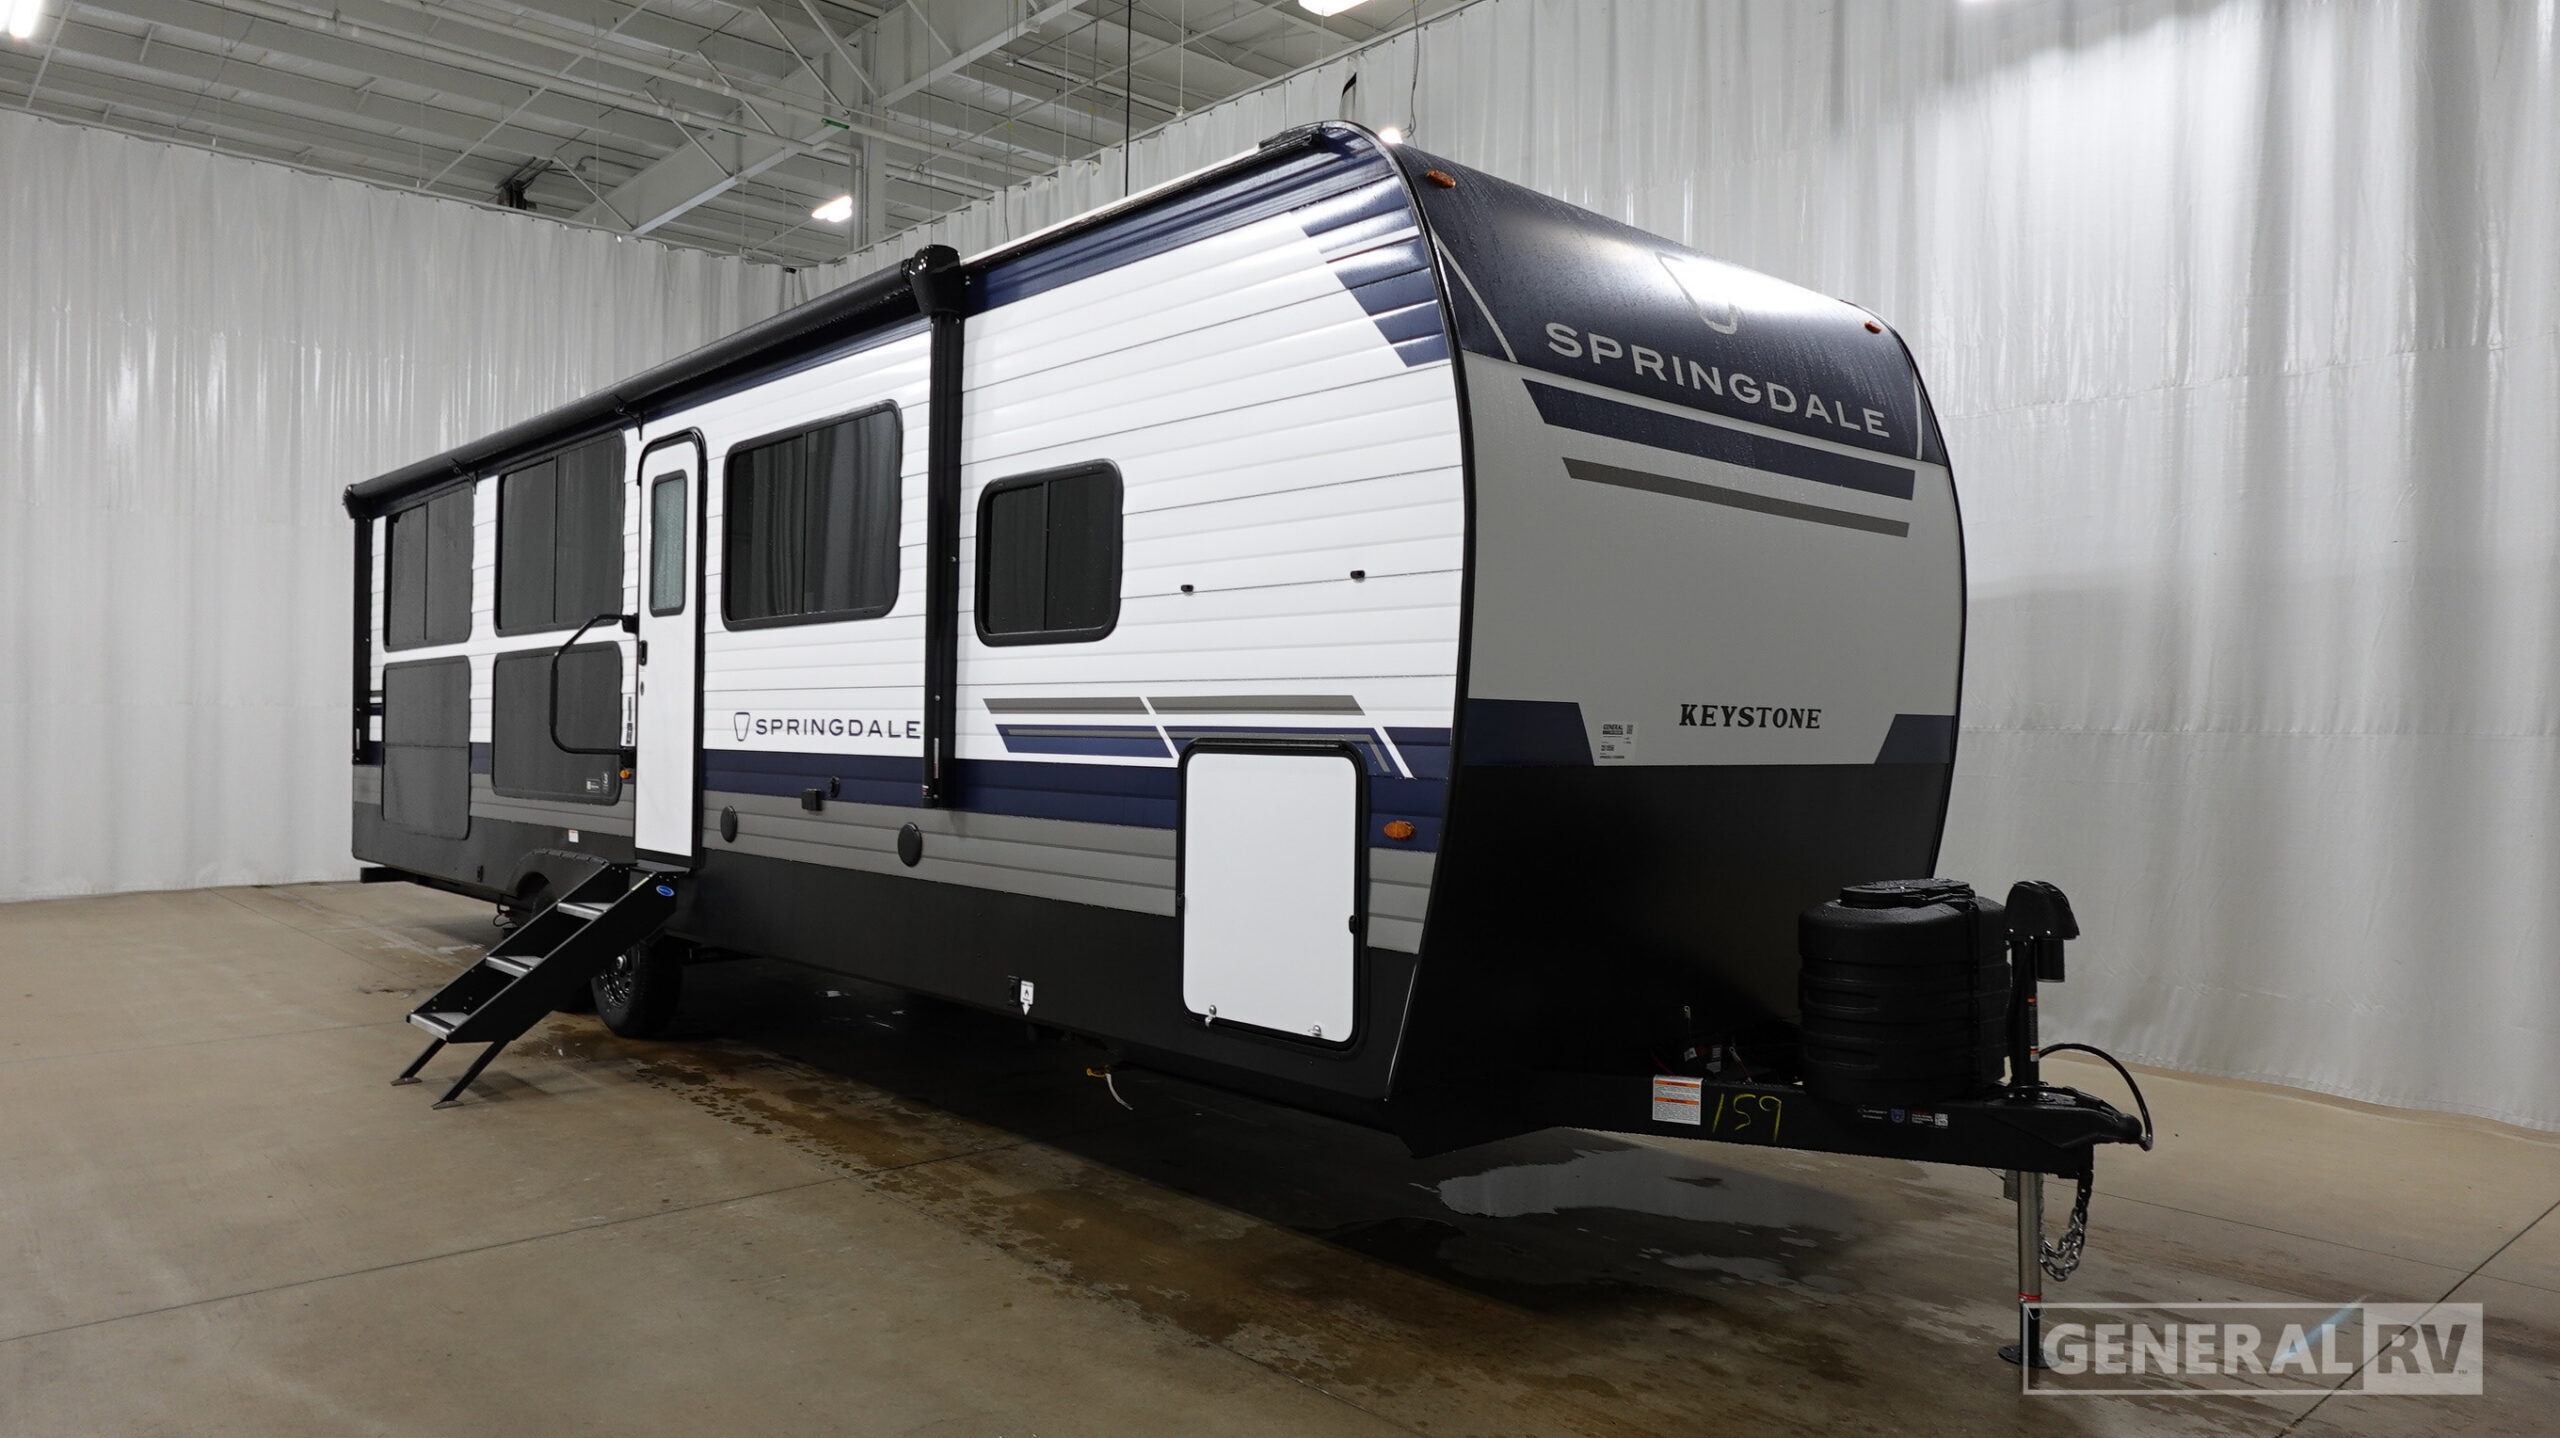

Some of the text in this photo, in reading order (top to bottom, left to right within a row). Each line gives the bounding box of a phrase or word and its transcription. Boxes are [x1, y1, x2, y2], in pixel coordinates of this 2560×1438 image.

[1545, 322, 1891, 438] SPRINGDALE
[755, 718, 921, 739] SPRINGDALE
[1679, 703, 1822, 729] KEYSTONE
[1712, 1093, 1783, 1143] 159
